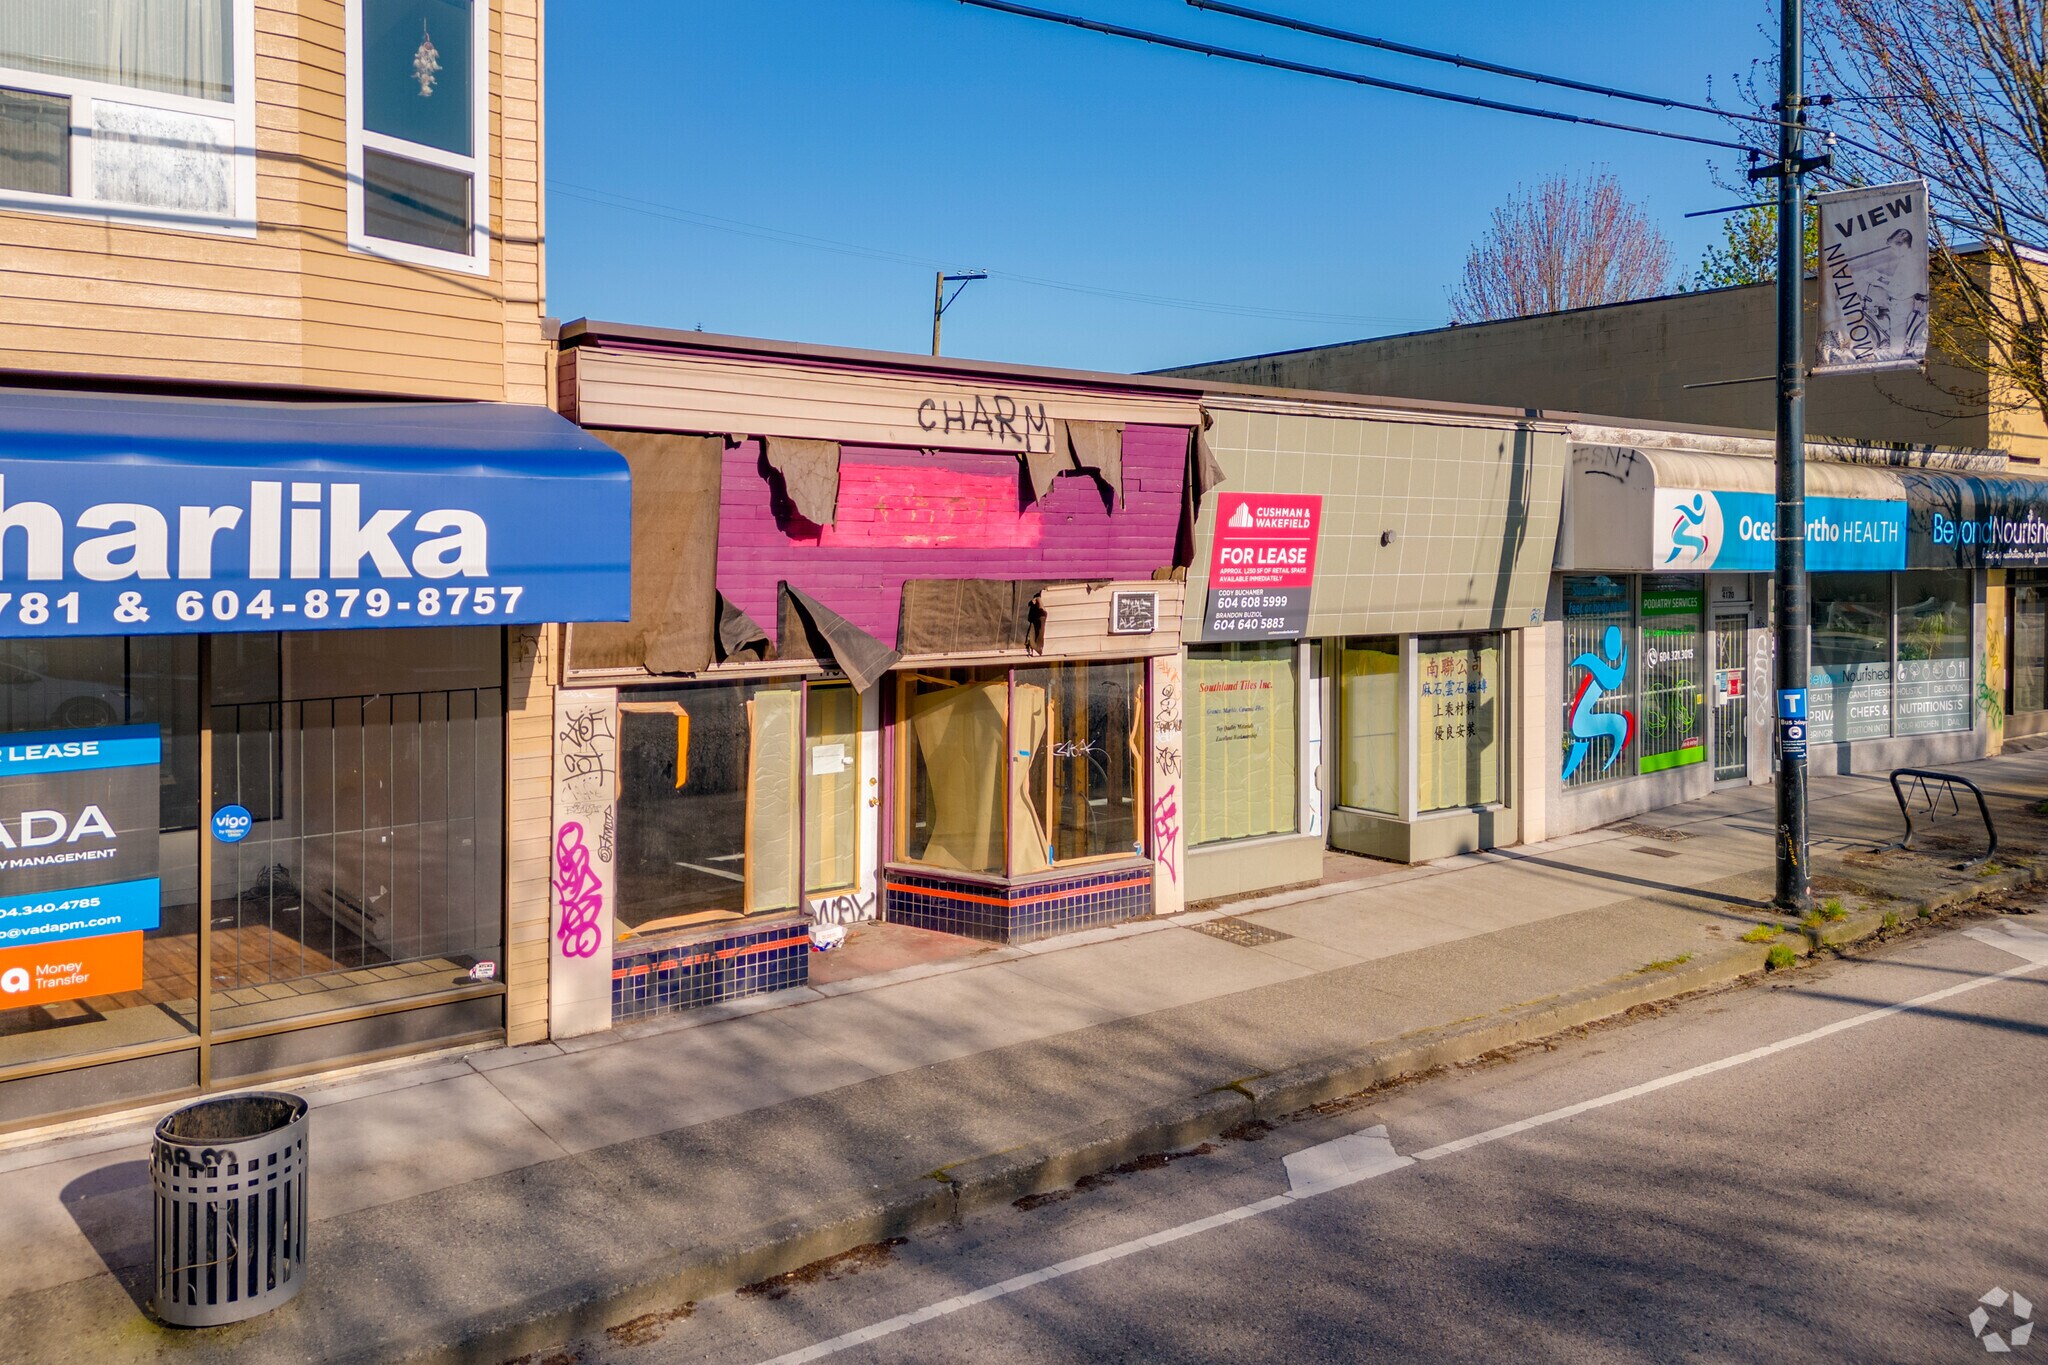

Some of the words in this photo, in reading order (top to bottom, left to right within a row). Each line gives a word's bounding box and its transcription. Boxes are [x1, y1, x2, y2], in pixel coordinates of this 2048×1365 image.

[1834, 194, 1913, 238] VIEW
[1824, 243, 1875, 360] MOUNTAIN
[918, 394, 1051, 453] CHARM
[1256, 507, 1302, 517] CUSHMAN
[1304, 508, 1311, 518] &
[1256, 518, 1310, 528] WAKEFIELD
[1804, 516, 1839, 542] rtho
[1843, 521, 1898, 542] HEALTH
[1220, 548, 1254, 564] FOR
[1258, 548, 1307, 564] LEASE
[113, 591, 150, 623] &
[176, 586, 523, 622] 604-879-8757
[1217, 597, 1238, 608] 604
[1241, 597, 1260, 608] 608
[1262, 596, 1288, 607] 5999
[1643, 598, 1671, 609] PODIATRY
[1672, 597, 1697, 608] SERVICES
[1213, 619, 1235, 630] 604
[1237, 619, 1258, 630] 640
[1260, 617, 1285, 629] 5883
[1199, 681, 1238, 692] Southland
[1240, 680, 1257, 690] Tiles
[1259, 680, 1273, 689] Inc.
[1933, 683, 1964, 694] DELICIOUS
[1784, 694, 1801, 713] T
[1850, 705, 1880, 719] CHEFS
[1882, 704, 1889, 716] &
[1899, 699, 1964, 714] NUTRITIONISTS
[1874, 724, 1888, 733] INTO
[1914, 719, 1939, 729] KITCHEN
[9, 741, 99, 762] LEASE
[216, 814, 249, 829] vigo
[10, 848, 117, 868] MANAGEMENT
[36, 962, 83, 975] Money
[36, 973, 90, 989] Transfer
